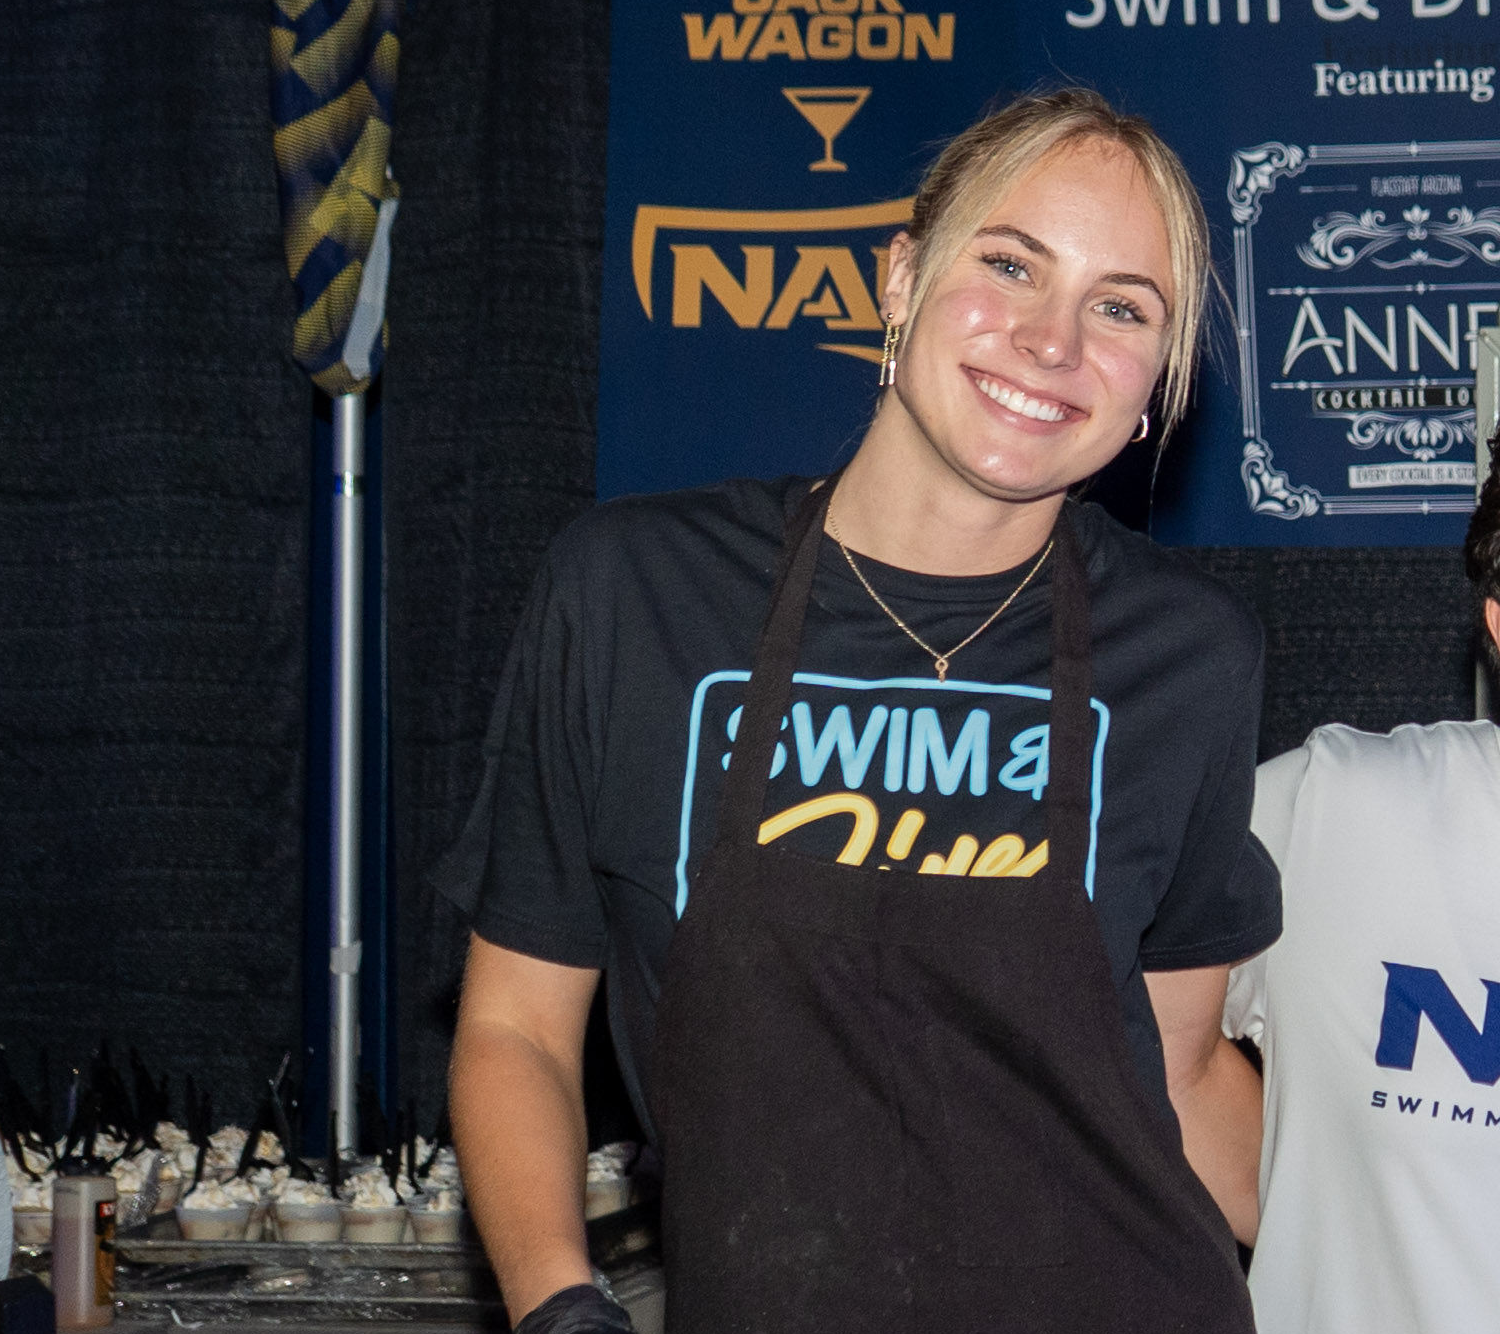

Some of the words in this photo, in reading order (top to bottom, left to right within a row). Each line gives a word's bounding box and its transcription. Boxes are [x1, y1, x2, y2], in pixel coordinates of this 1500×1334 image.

[684, 12, 955, 61] WAGON
[1313, 58, 1496, 103] Featuring
[1421, 174, 1463, 195] ARIZONA
[1316, 389, 1428, 410] COCKTAIL
